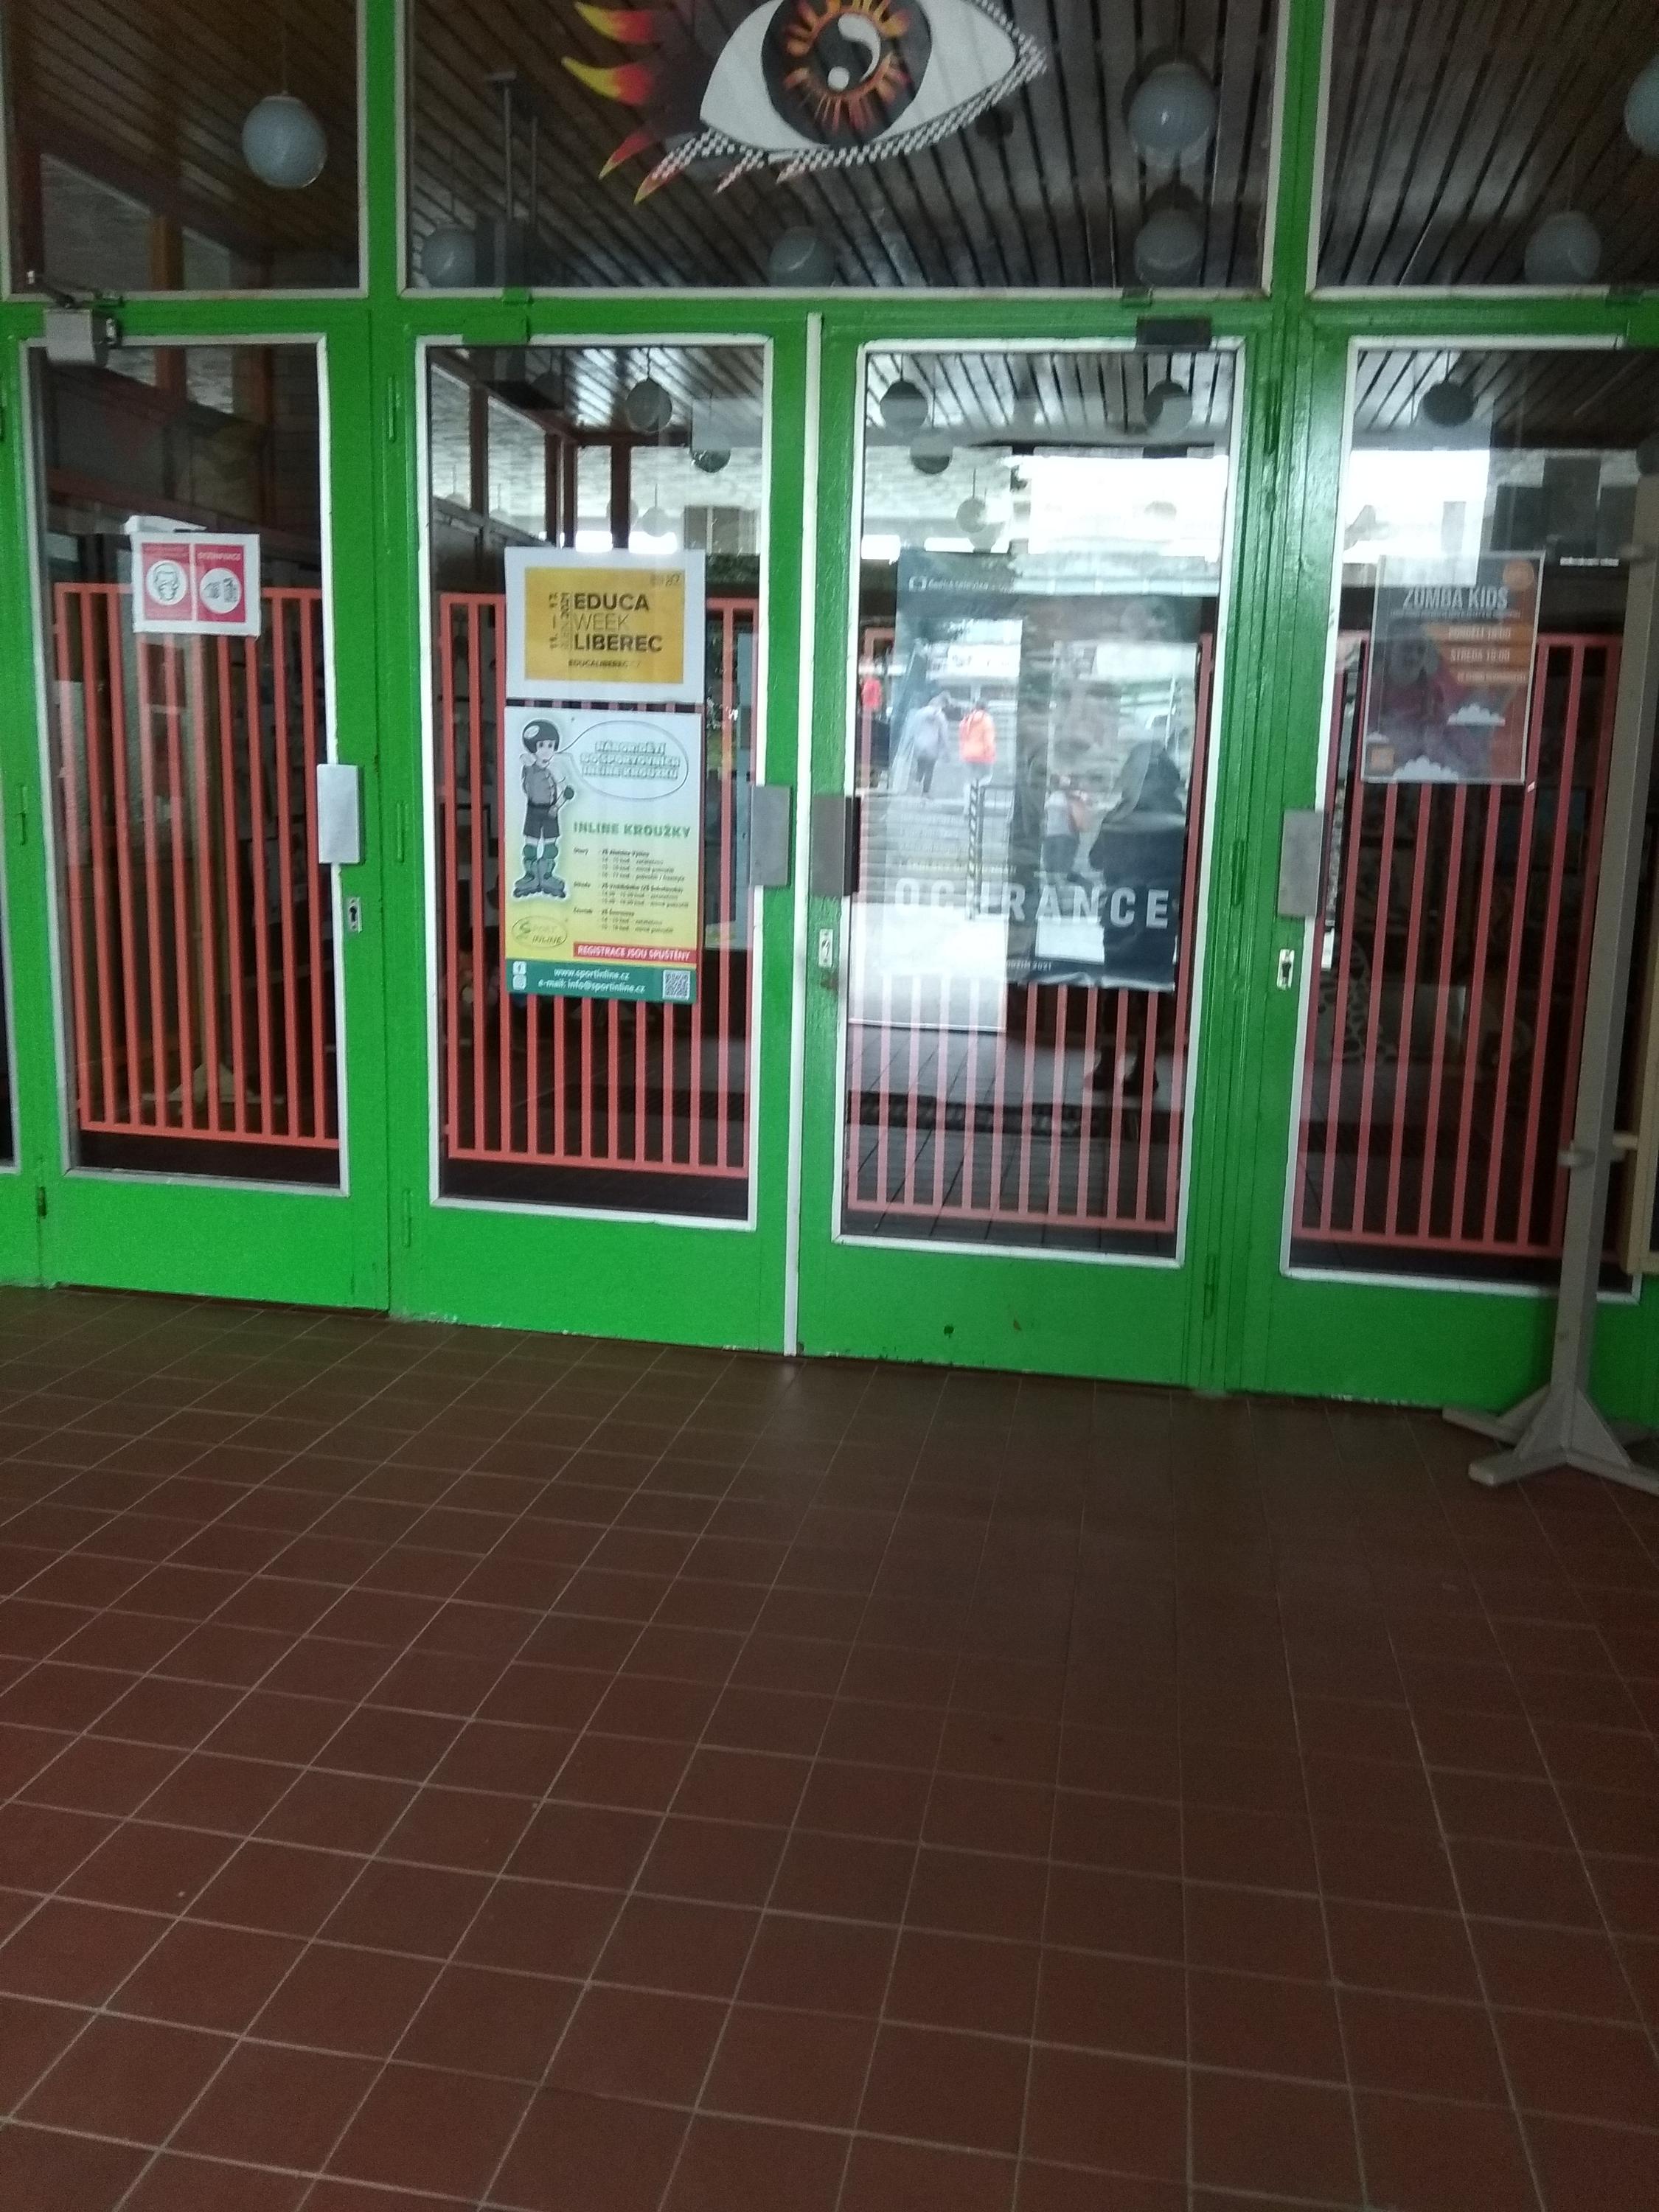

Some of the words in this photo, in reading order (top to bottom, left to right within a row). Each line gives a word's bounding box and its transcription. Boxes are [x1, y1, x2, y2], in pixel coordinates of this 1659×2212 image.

[574, 593, 650, 611] EDUCA
[1403, 586, 1464, 608] ZUMBA
[1468, 585, 1511, 609] KIDS
[574, 613, 630, 631] WEEK
[574, 633, 663, 653] LIBEREC
[574, 821, 619, 835] INLINE
[624, 823, 691, 838] KROUŽKY
[577, 945, 626, 958] REGISTRACE
[554, 967, 630, 981] www.sportinline.cz
[567, 978, 646, 994] info@sportinline.cz
